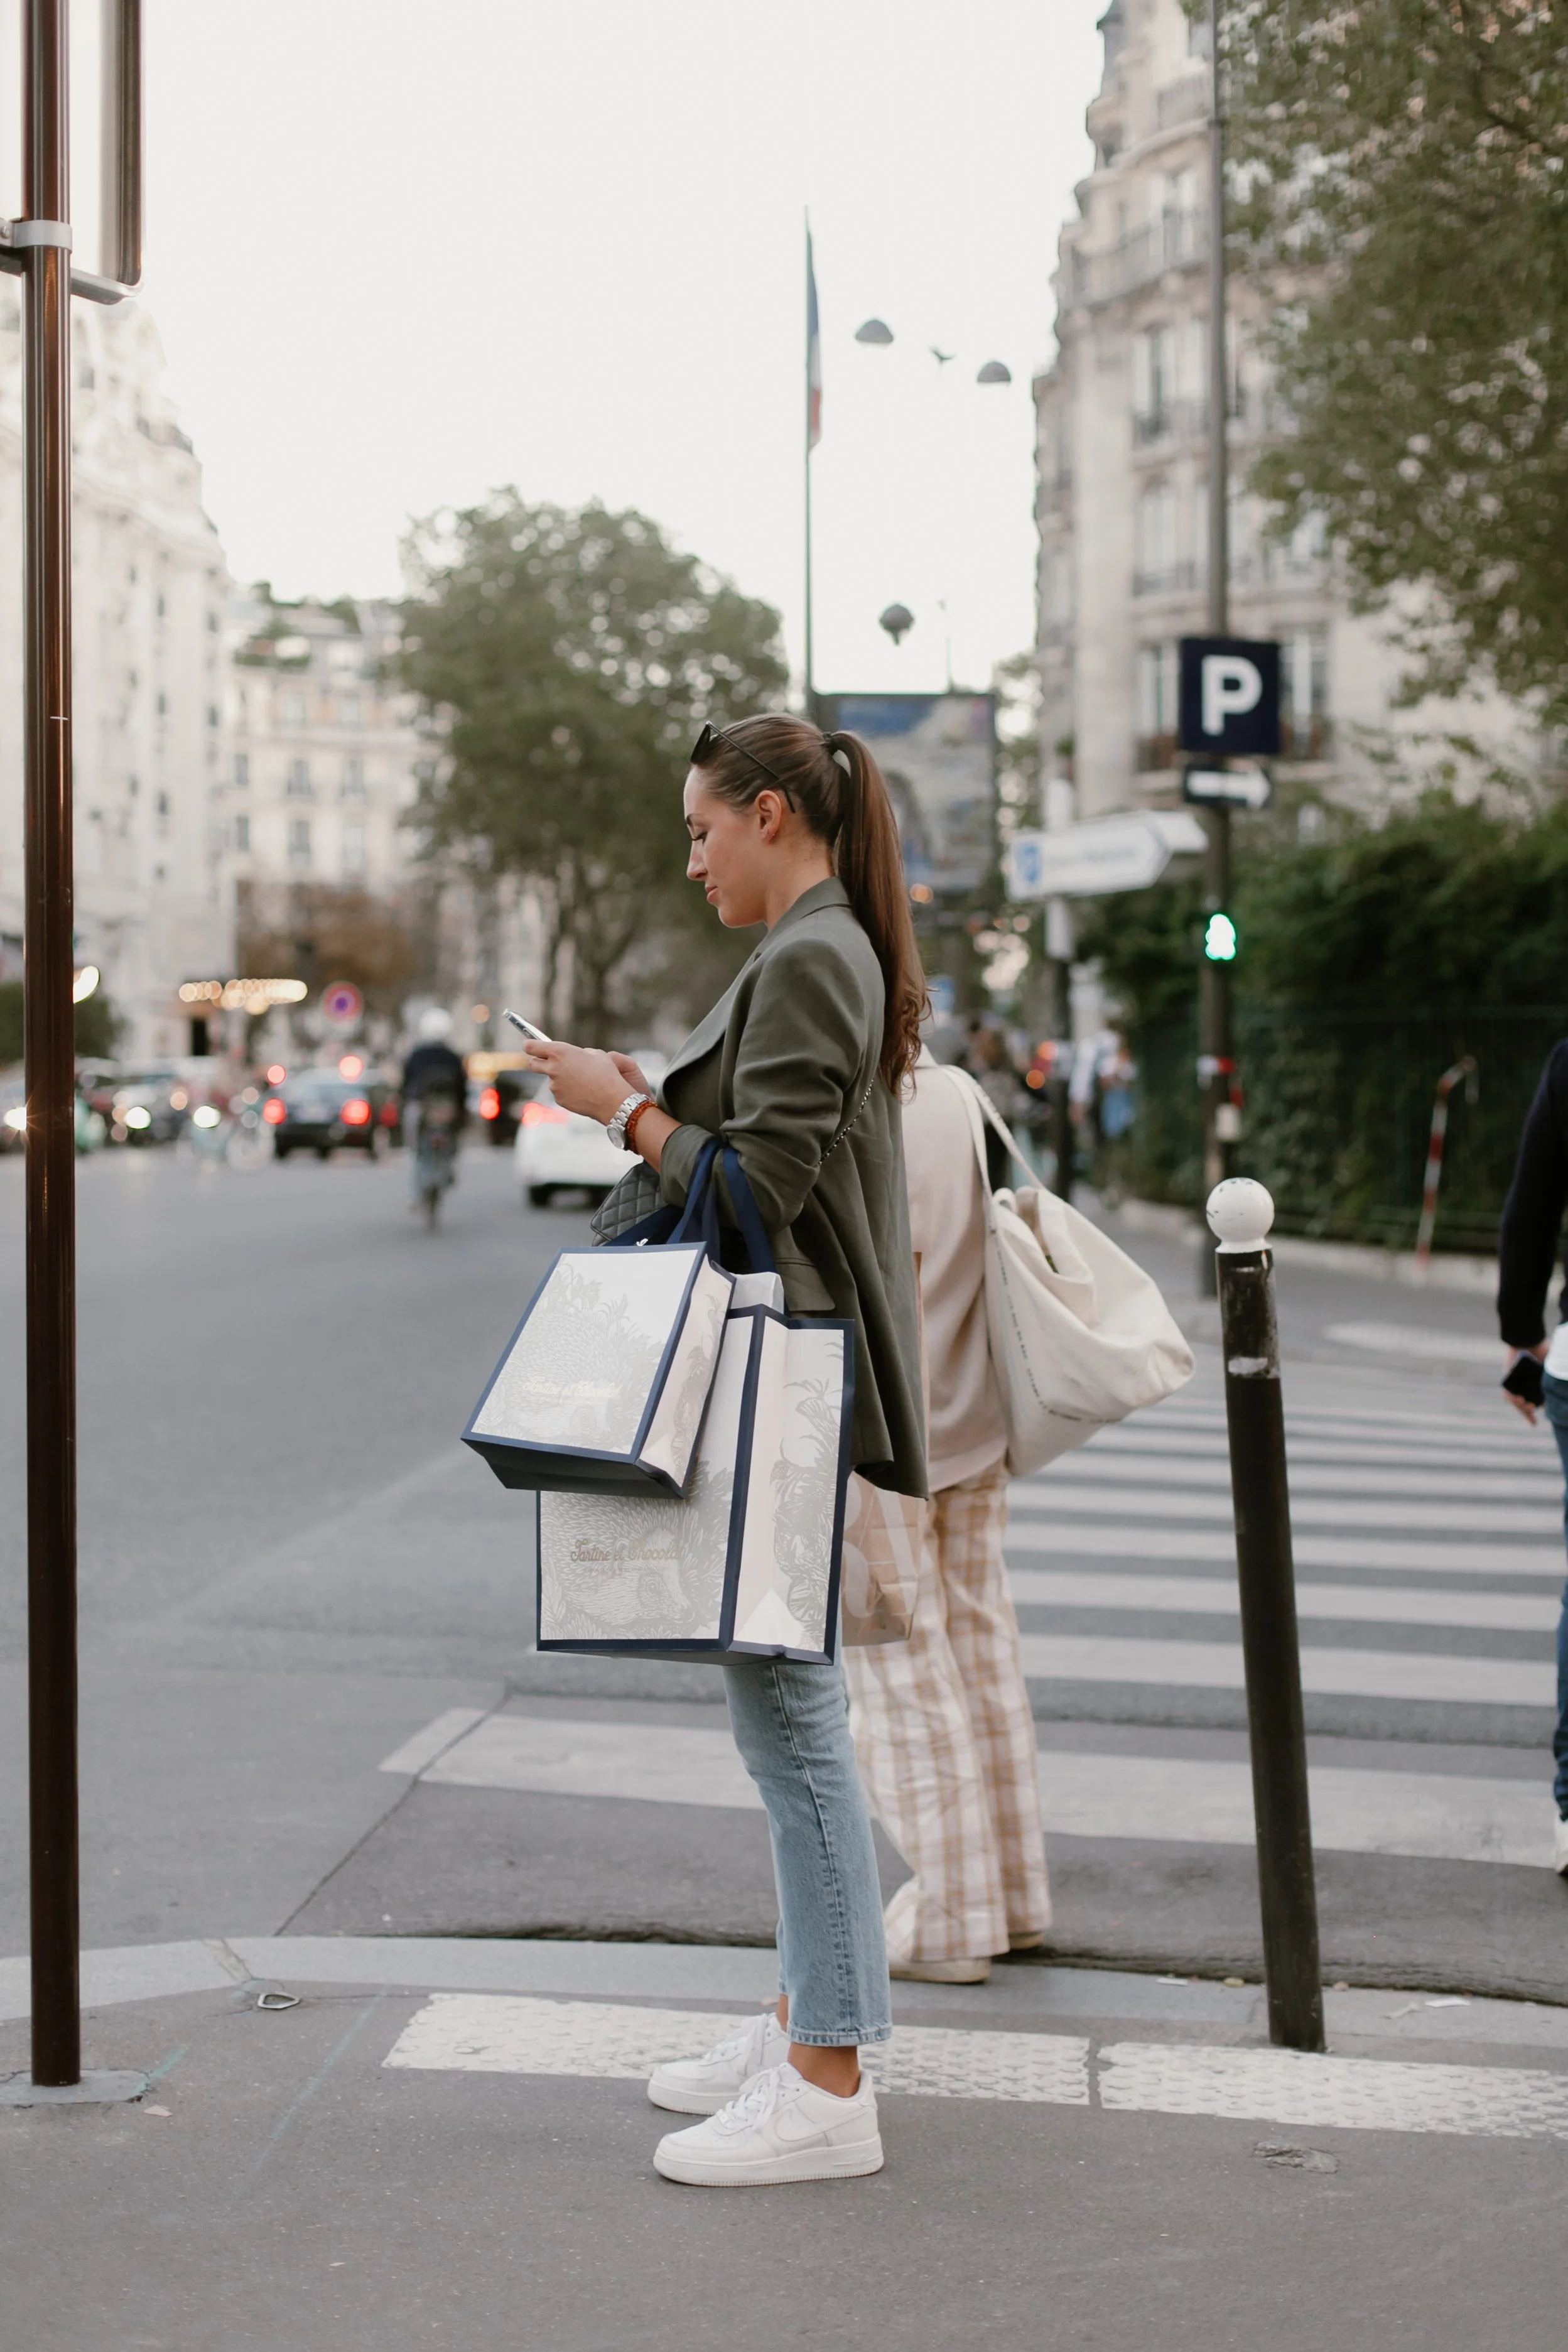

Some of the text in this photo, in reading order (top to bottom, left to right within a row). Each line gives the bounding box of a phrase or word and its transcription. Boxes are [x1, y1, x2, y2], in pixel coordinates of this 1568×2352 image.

[1201, 654, 1263, 736] P
[570, 1538, 688, 1562] Tartine et Chocolat
